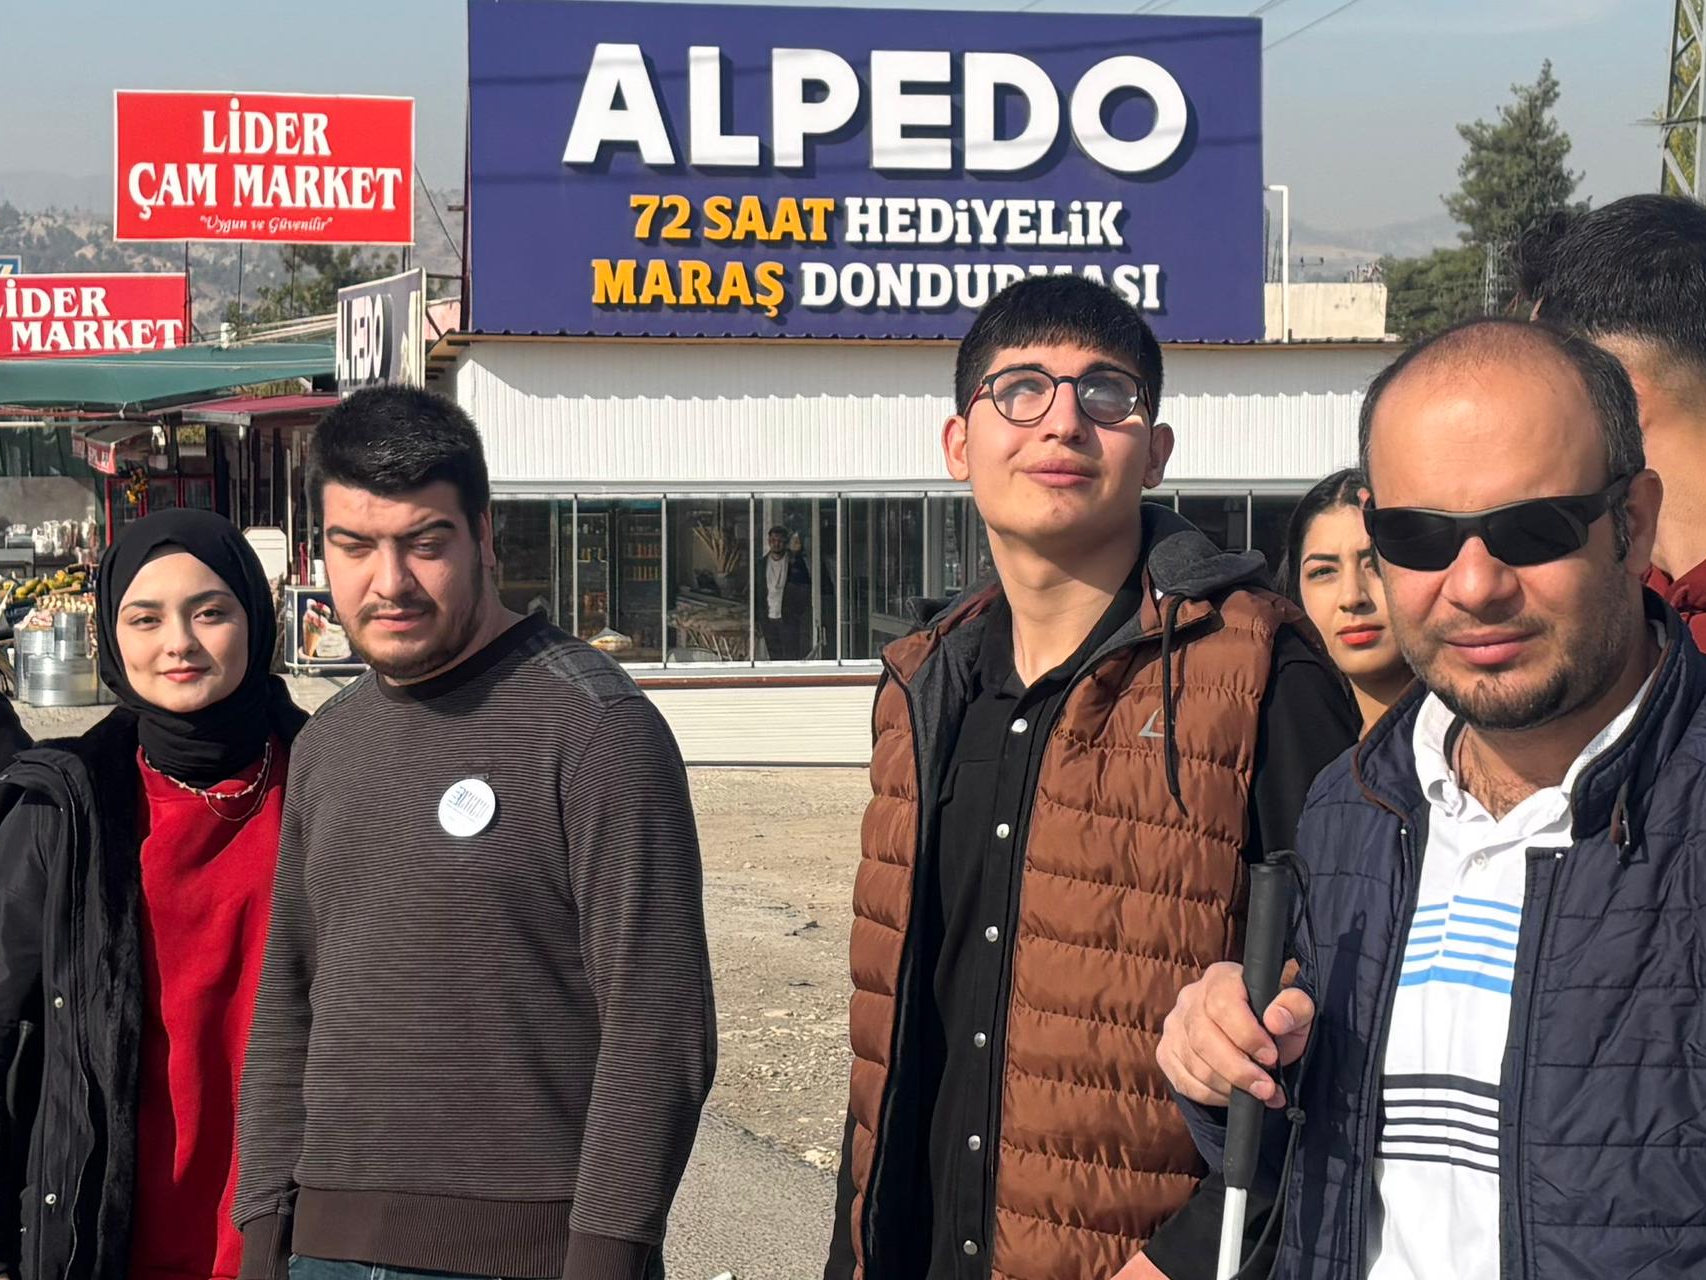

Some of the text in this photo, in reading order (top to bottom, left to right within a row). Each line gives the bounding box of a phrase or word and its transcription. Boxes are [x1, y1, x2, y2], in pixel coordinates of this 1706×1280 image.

[202, 97, 332, 156] LİDER
[562, 43, 1187, 172] ALPEDO
[128, 162, 403, 220] ÇAM MARKET
[630, 195, 691, 239] 72
[703, 196, 834, 241] SAAT
[250, 219, 266, 231] ve
[591, 259, 1160, 317] MARAŞ DONDURSI
[12, 319, 183, 352] MARKET
